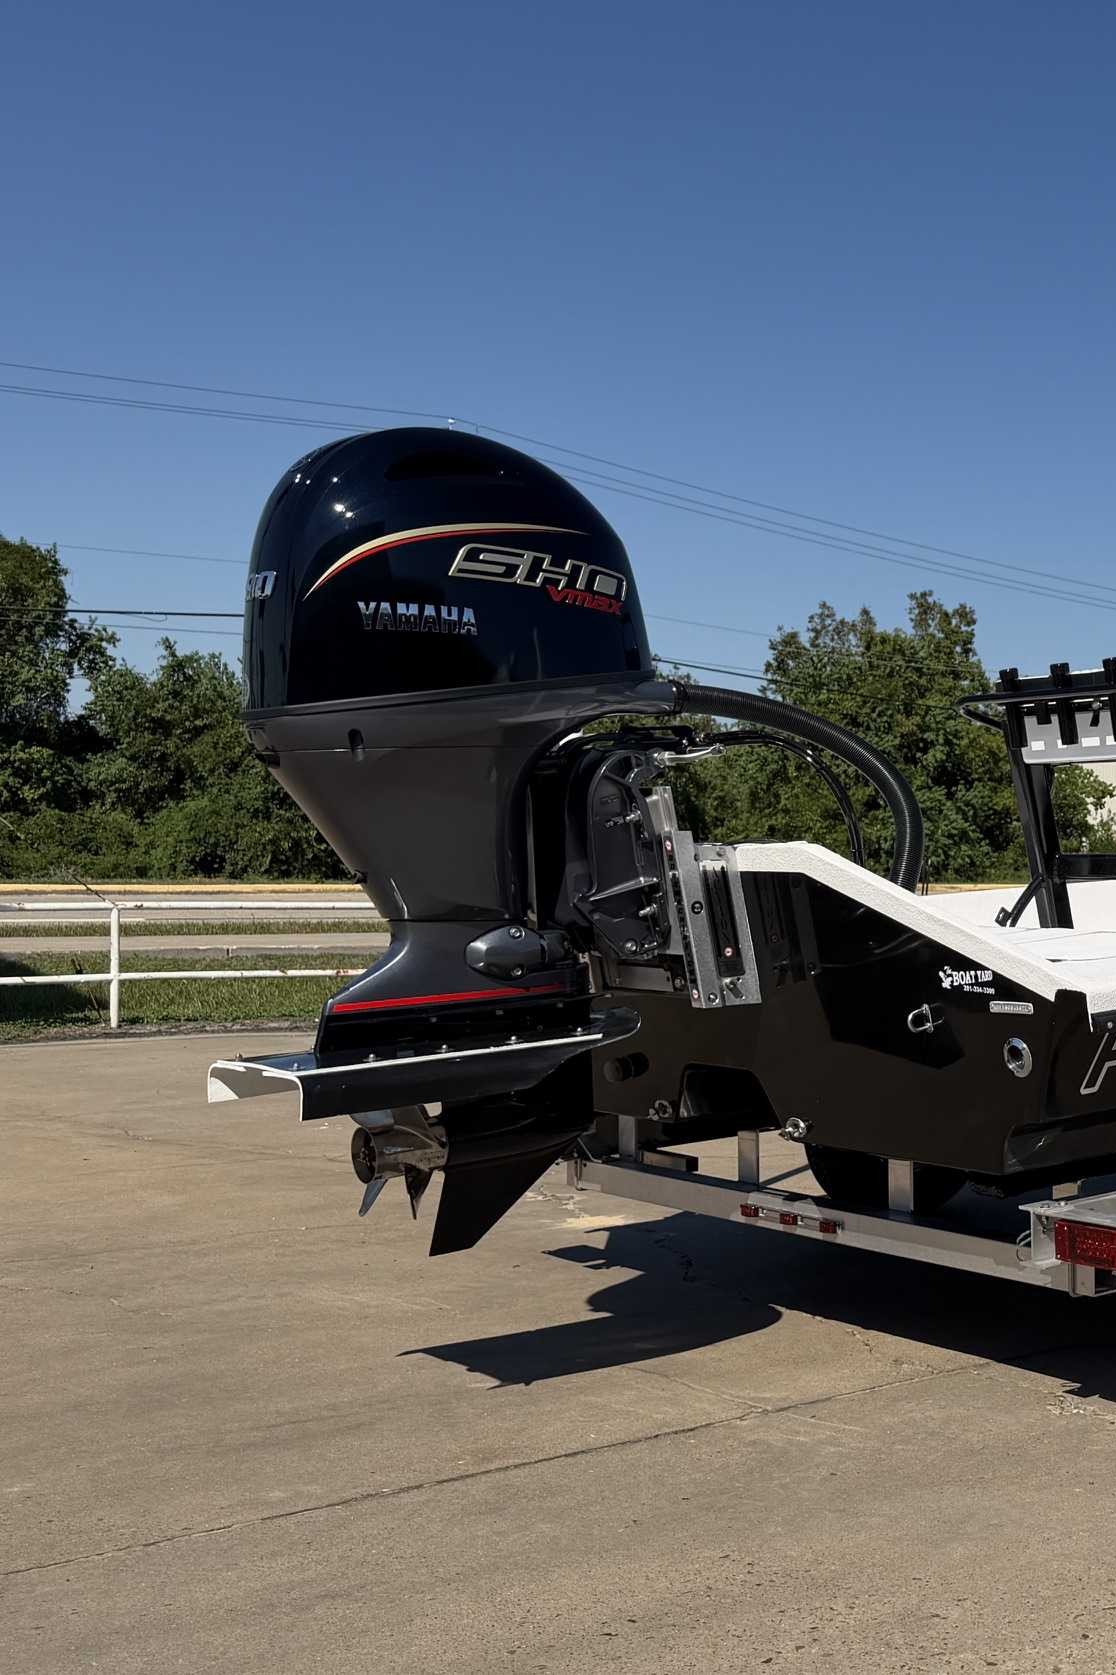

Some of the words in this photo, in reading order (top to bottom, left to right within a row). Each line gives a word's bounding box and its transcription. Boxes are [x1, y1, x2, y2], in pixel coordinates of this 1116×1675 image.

[448, 543, 628, 601] SHO
[356, 601, 478, 636] YAMAHA
[951, 970, 976, 986] BOAT
[976, 969, 993, 982] YARD
